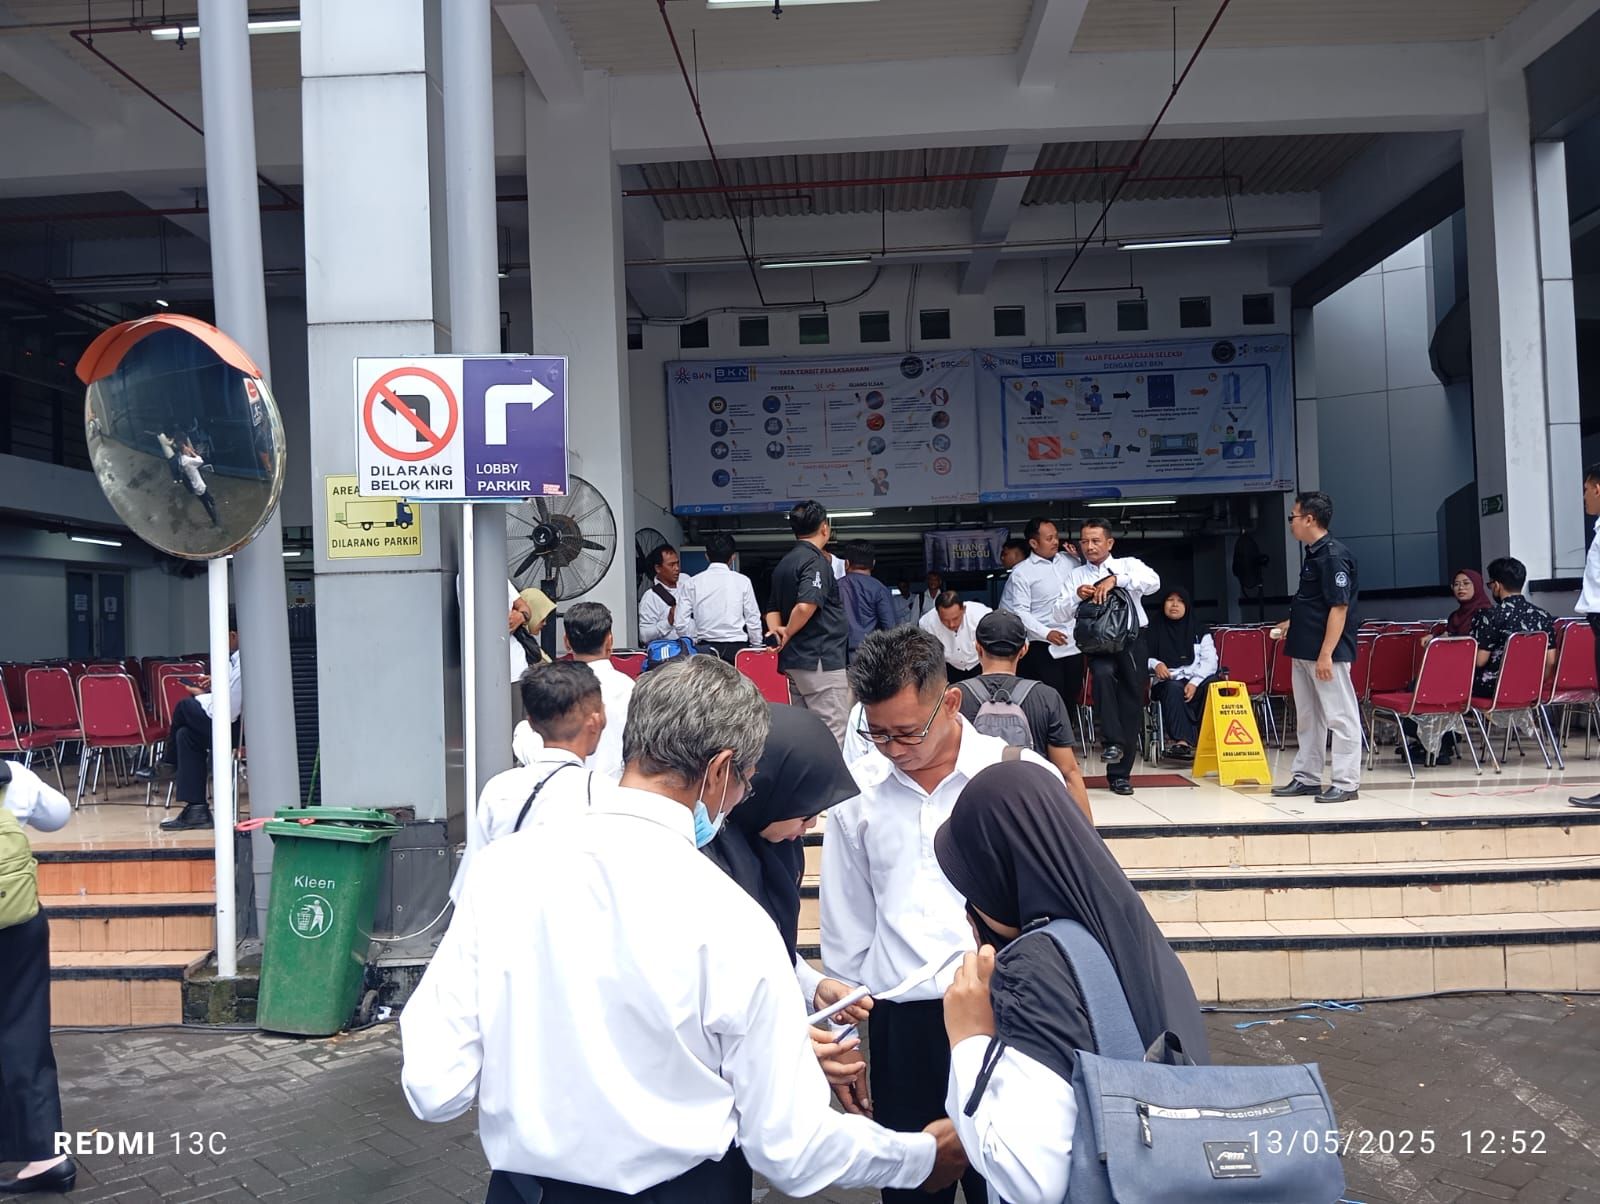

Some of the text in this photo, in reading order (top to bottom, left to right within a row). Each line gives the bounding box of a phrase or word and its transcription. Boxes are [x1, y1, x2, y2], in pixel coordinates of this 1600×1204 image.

[1023, 353, 1055, 363] BKN
[819, 366, 870, 374] PELAKSANAAN
[1103, 361, 1133, 370] DENGAN
[692, 372, 712, 380] BKN
[716, 369, 748, 377] BKN
[370, 465, 453, 476] DILARANG
[476, 463, 519, 475] LOBBY
[371, 480, 453, 491] BELOK KIRI
[477, 480, 531, 491] PARKIR
[331, 536, 418, 549] DILARANG PARKIR
[952, 543, 985, 551] RUANG
[952, 550, 990, 559] TUNGGU
[294, 875, 335, 889] Kleen
